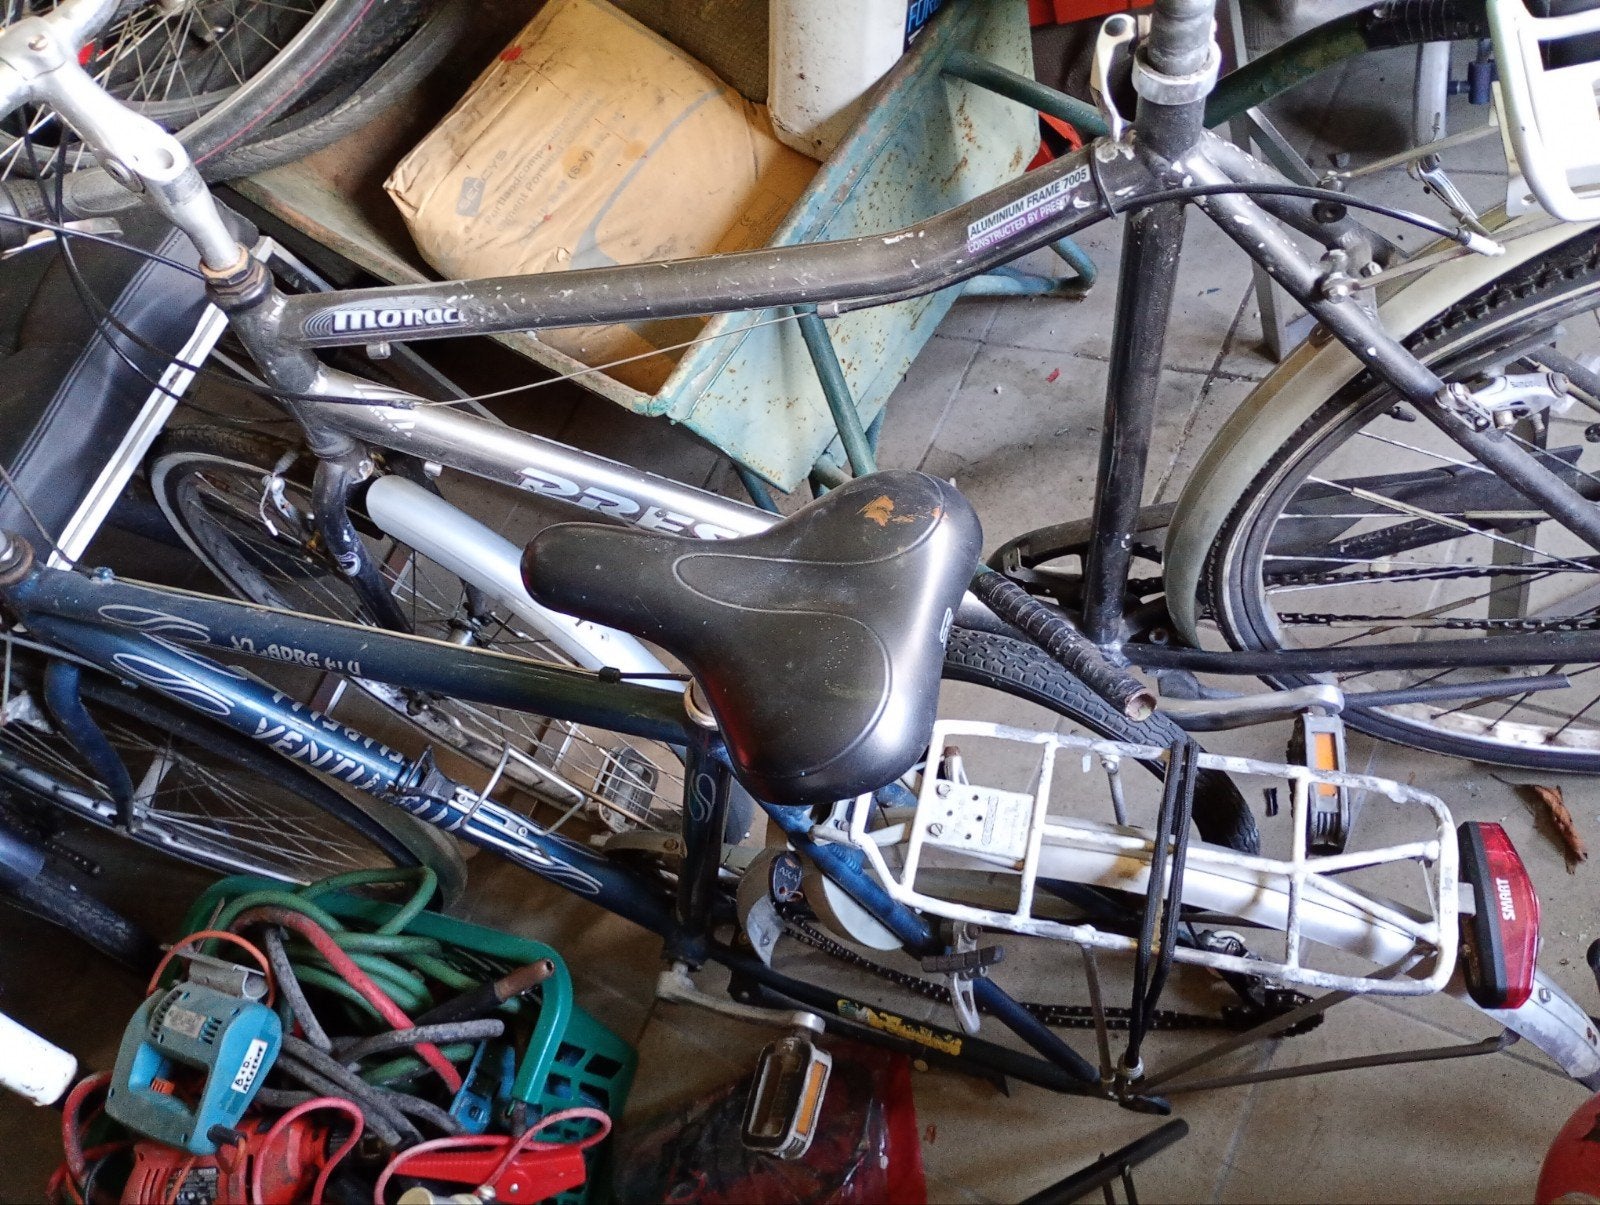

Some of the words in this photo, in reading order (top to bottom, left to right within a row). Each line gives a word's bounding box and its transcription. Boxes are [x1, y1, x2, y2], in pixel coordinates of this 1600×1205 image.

[970, 201, 1025, 237] ALUMINIUM
[1027, 183, 1061, 210] FRAME
[1063, 169, 1088, 190] 7005
[967, 218, 1027, 253] CONSTRUCTED
[1027, 210, 1039, 225] BY
[1495, 877, 1516, 921] SMART
